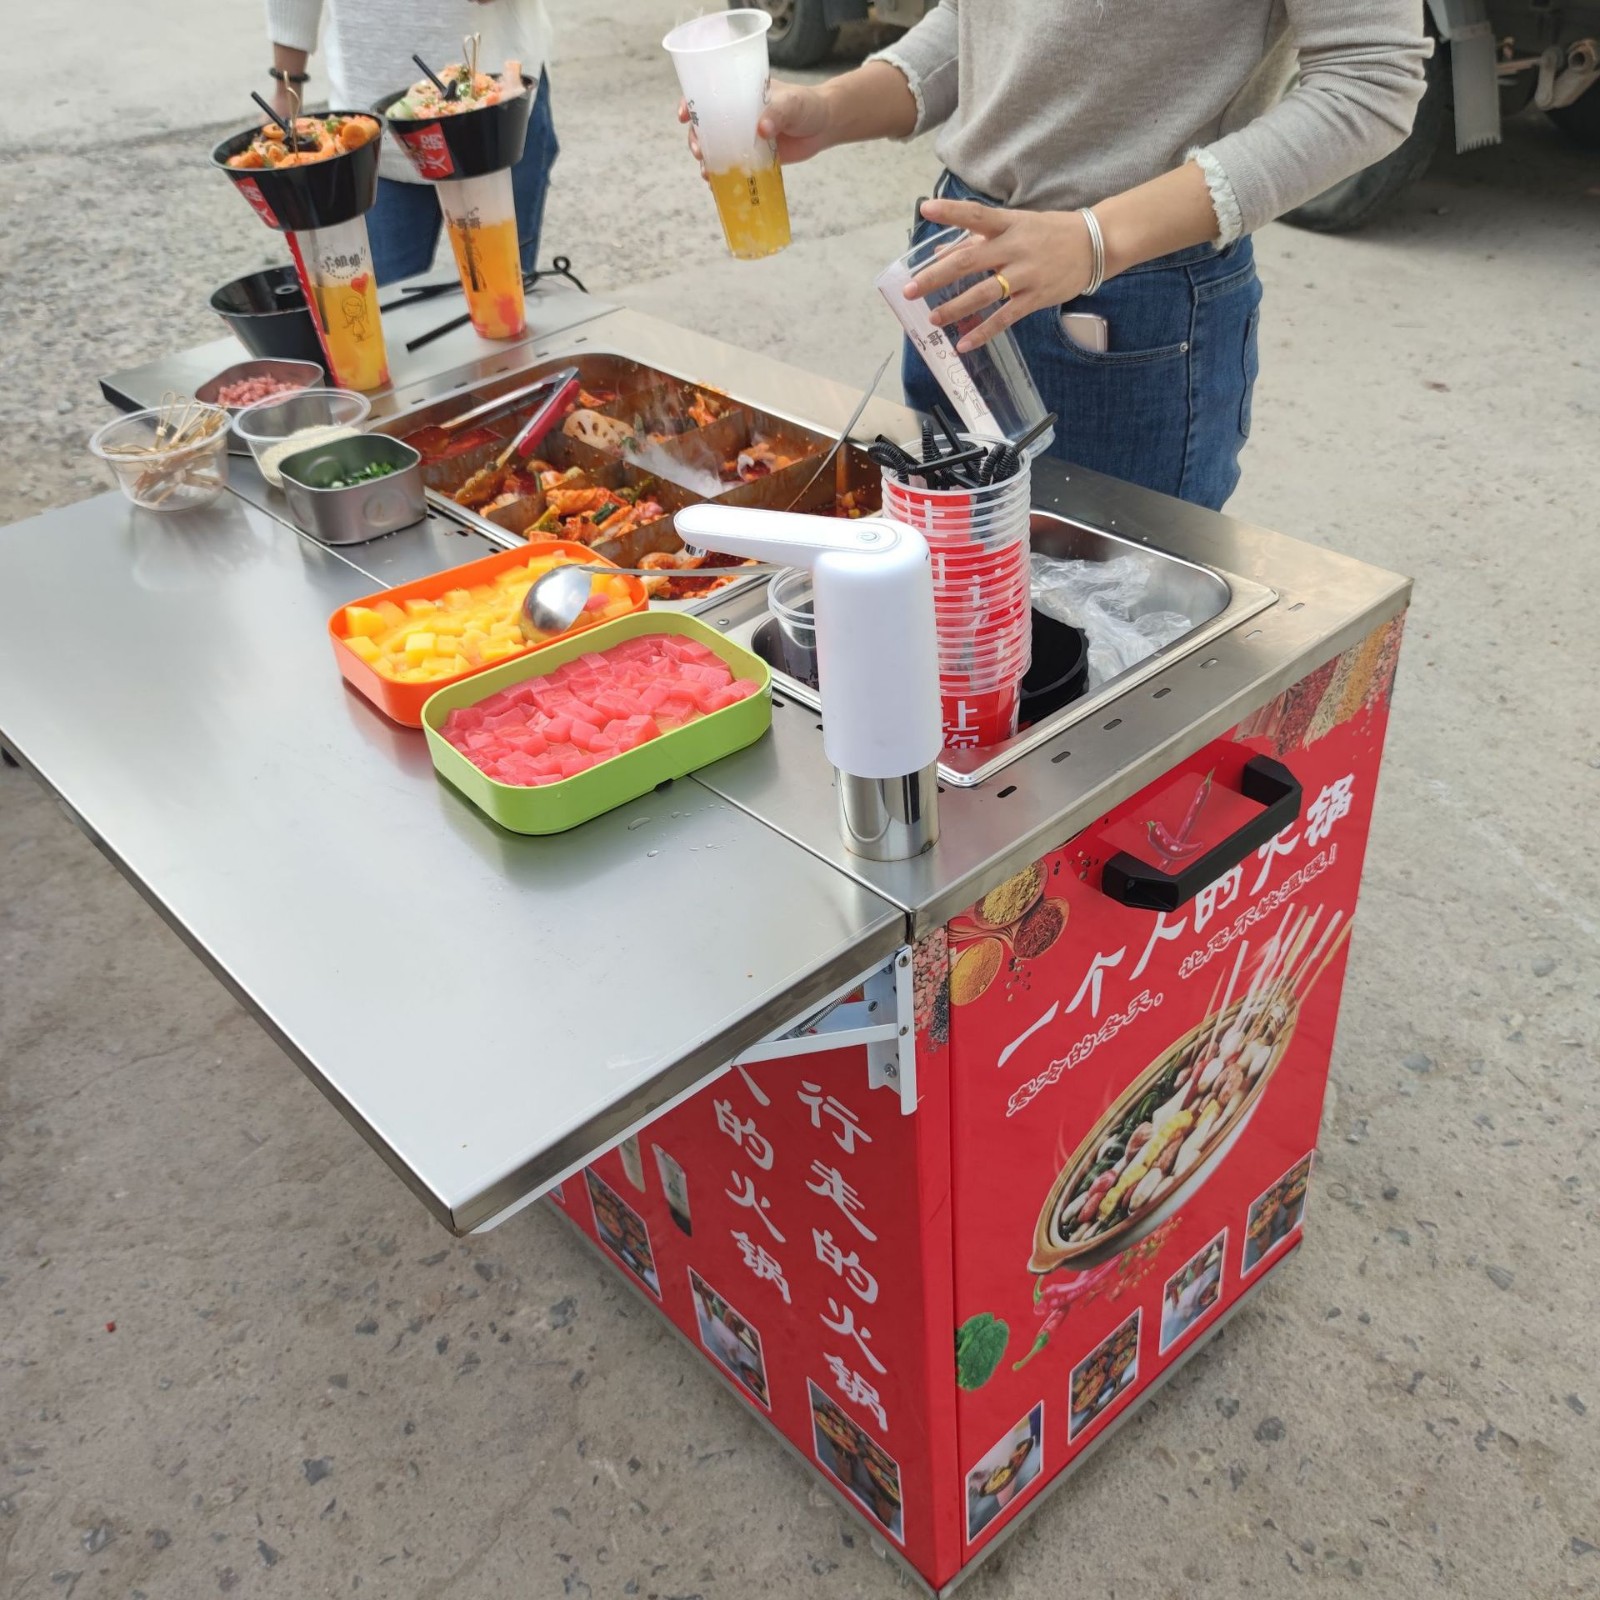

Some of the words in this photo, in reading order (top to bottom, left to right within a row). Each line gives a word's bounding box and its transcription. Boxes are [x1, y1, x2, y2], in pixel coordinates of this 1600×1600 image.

[997, 773, 1355, 1067] 一个人的火锅
[797, 1080, 888, 1431] 行走的火锅
